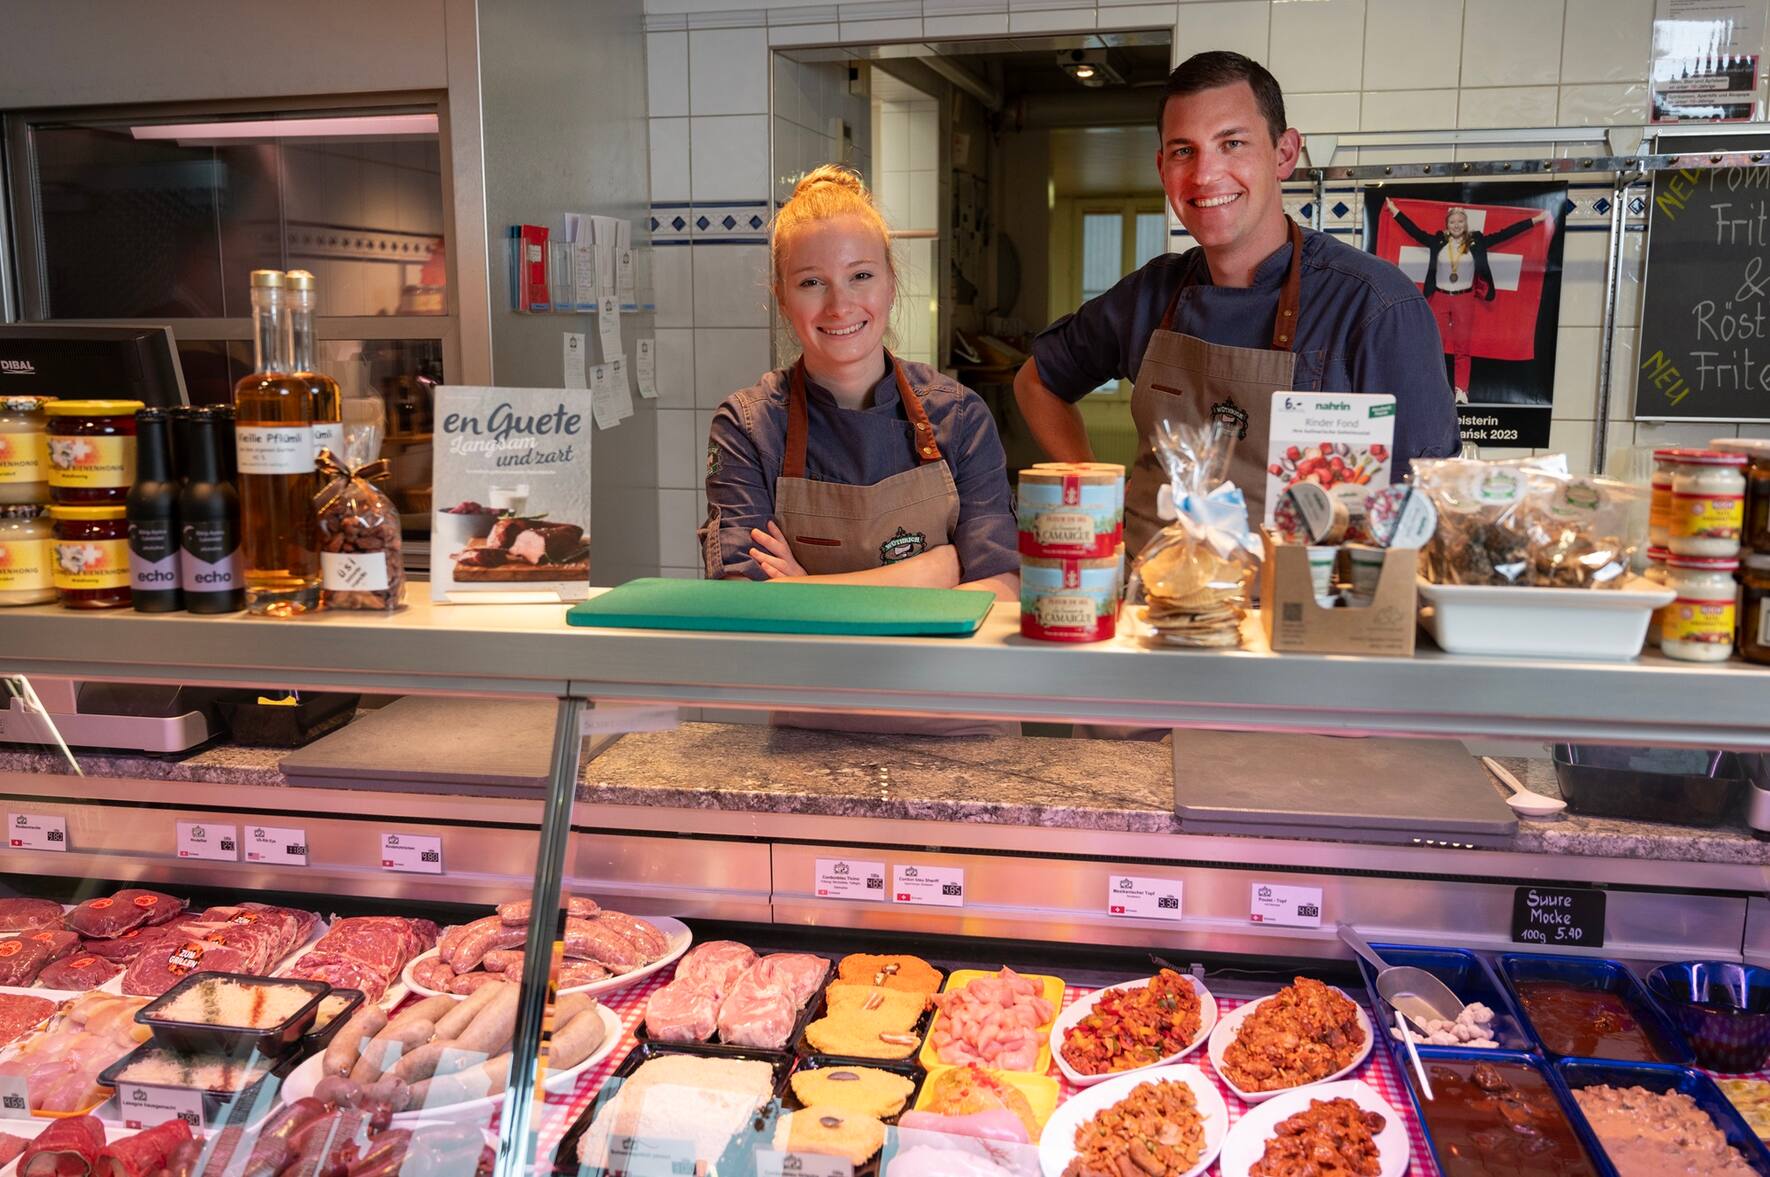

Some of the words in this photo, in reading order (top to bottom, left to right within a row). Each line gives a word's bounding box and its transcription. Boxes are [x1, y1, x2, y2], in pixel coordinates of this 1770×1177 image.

[0, 360, 34, 370] DIBAL
[1641, 350, 1690, 406] NEU
[1315, 401, 1351, 411] nahrin
[443, 413, 483, 435] en
[487, 403, 581, 444] Guete
[1336, 418, 1360, 428] Fond
[1490, 430, 1518, 440] 2023
[450, 435, 538, 458] Langsam
[496, 448, 534, 467] und
[535, 445, 574, 465] zart
[138, 570, 174, 582] echo
[195, 570, 231, 583] echo
[1530, 908, 1572, 925] Mocke
[1521, 929, 1546, 944] 100g
[180, 949, 196, 960] ZUM
